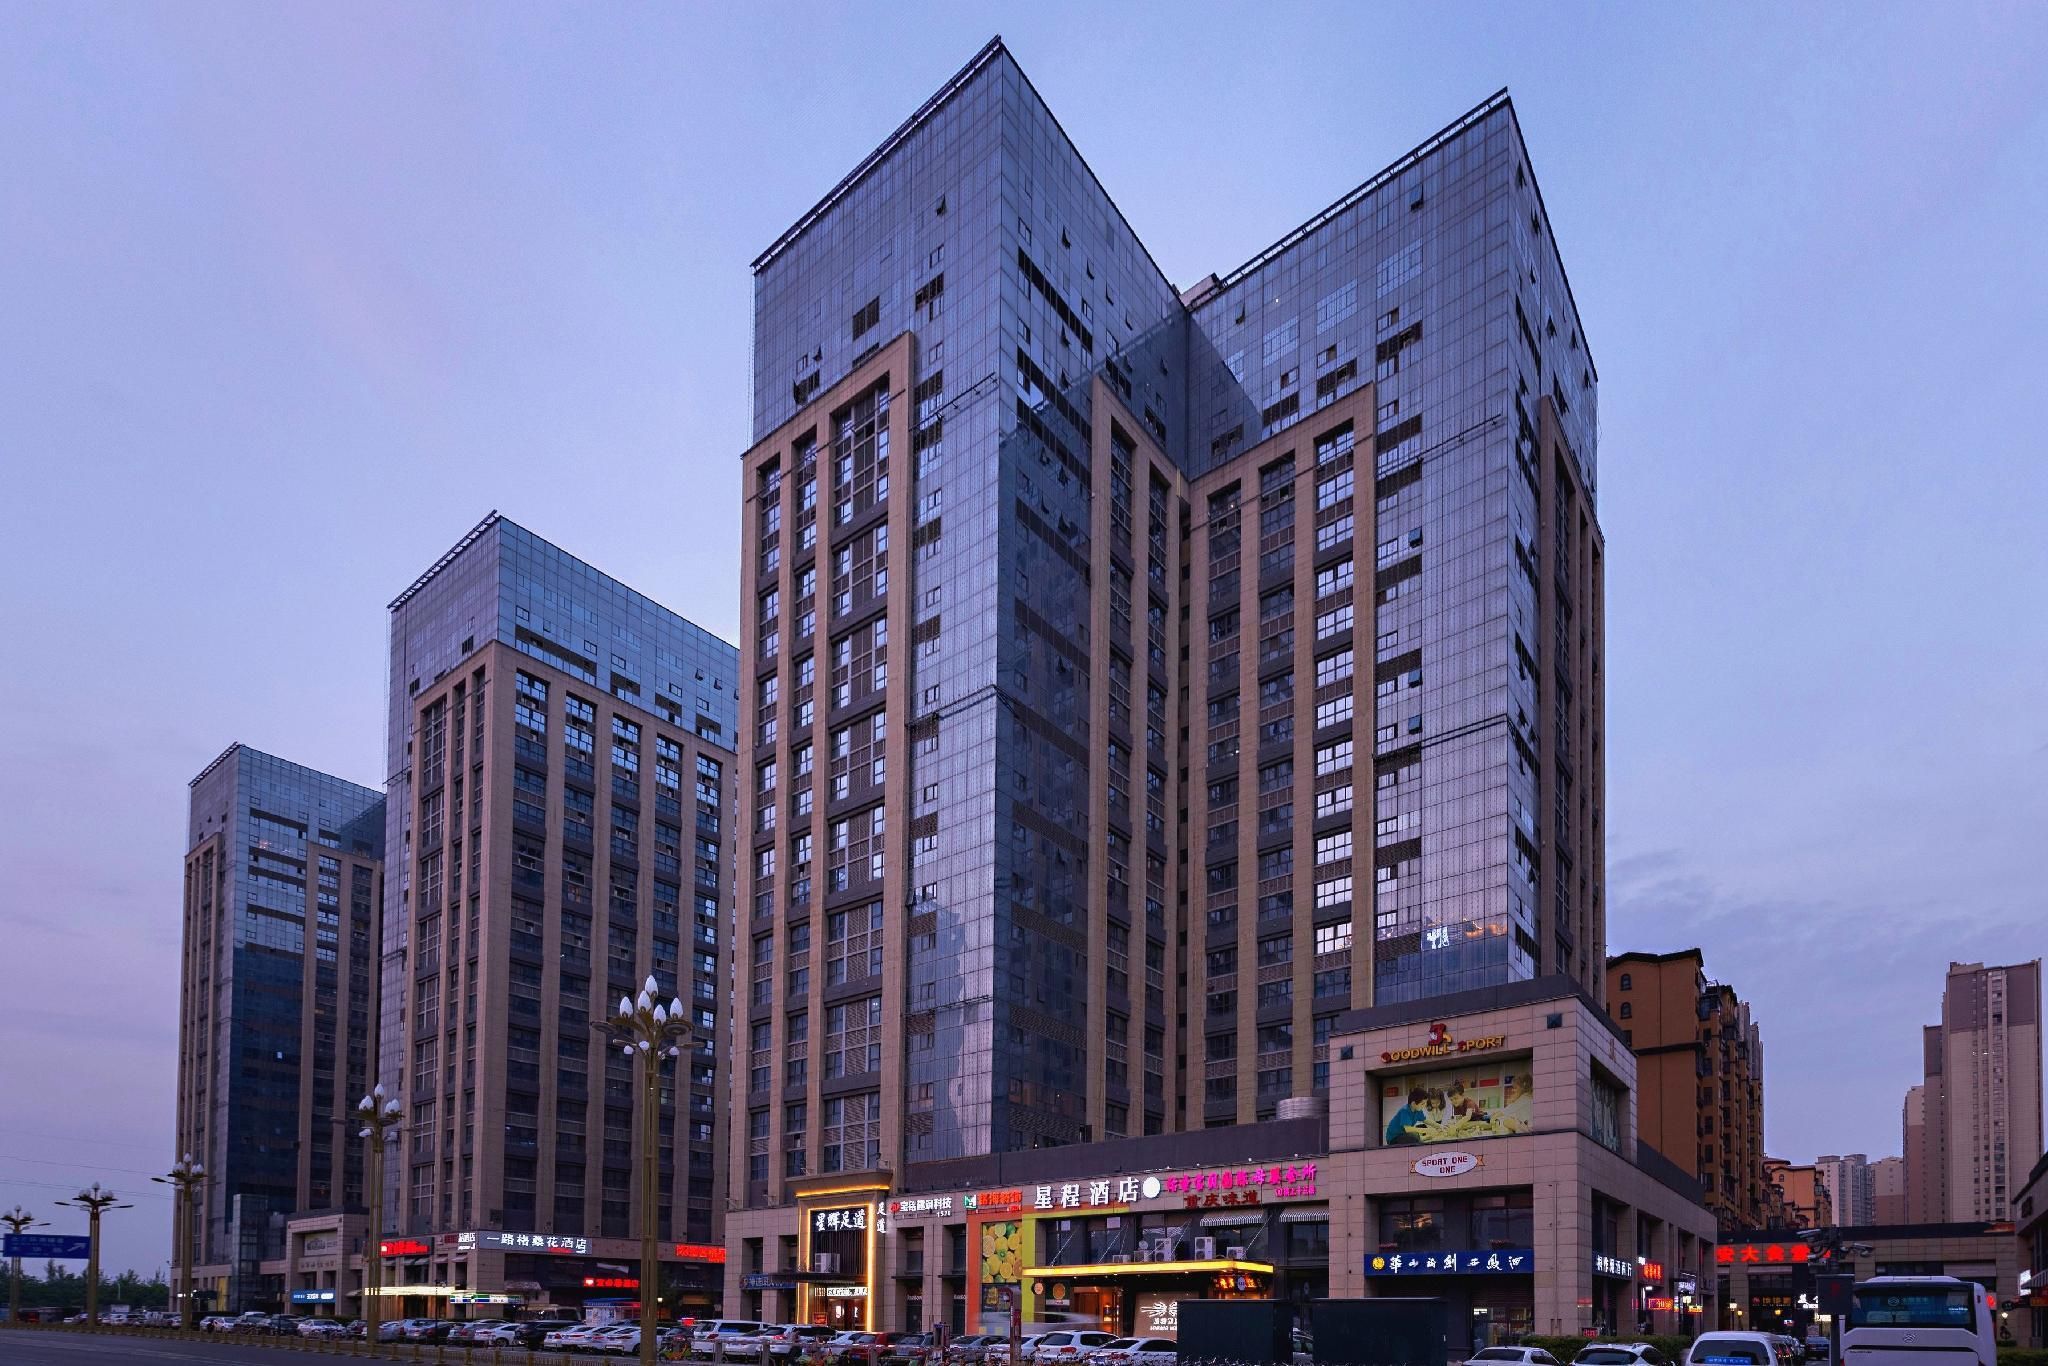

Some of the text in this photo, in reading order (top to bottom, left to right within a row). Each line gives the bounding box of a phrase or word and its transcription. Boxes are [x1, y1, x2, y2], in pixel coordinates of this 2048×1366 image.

[1422, 1155, 1468, 1167] SPORT ONE
[1439, 1165, 1456, 1174] ONE
[1033, 1176, 1140, 1209] 星程酒店
[1183, 1189, 1261, 1209] 重庆味道
[815, 1208, 868, 1232] 星辉足道
[486, 1233, 588, 1250] 一路格桑花酒店
